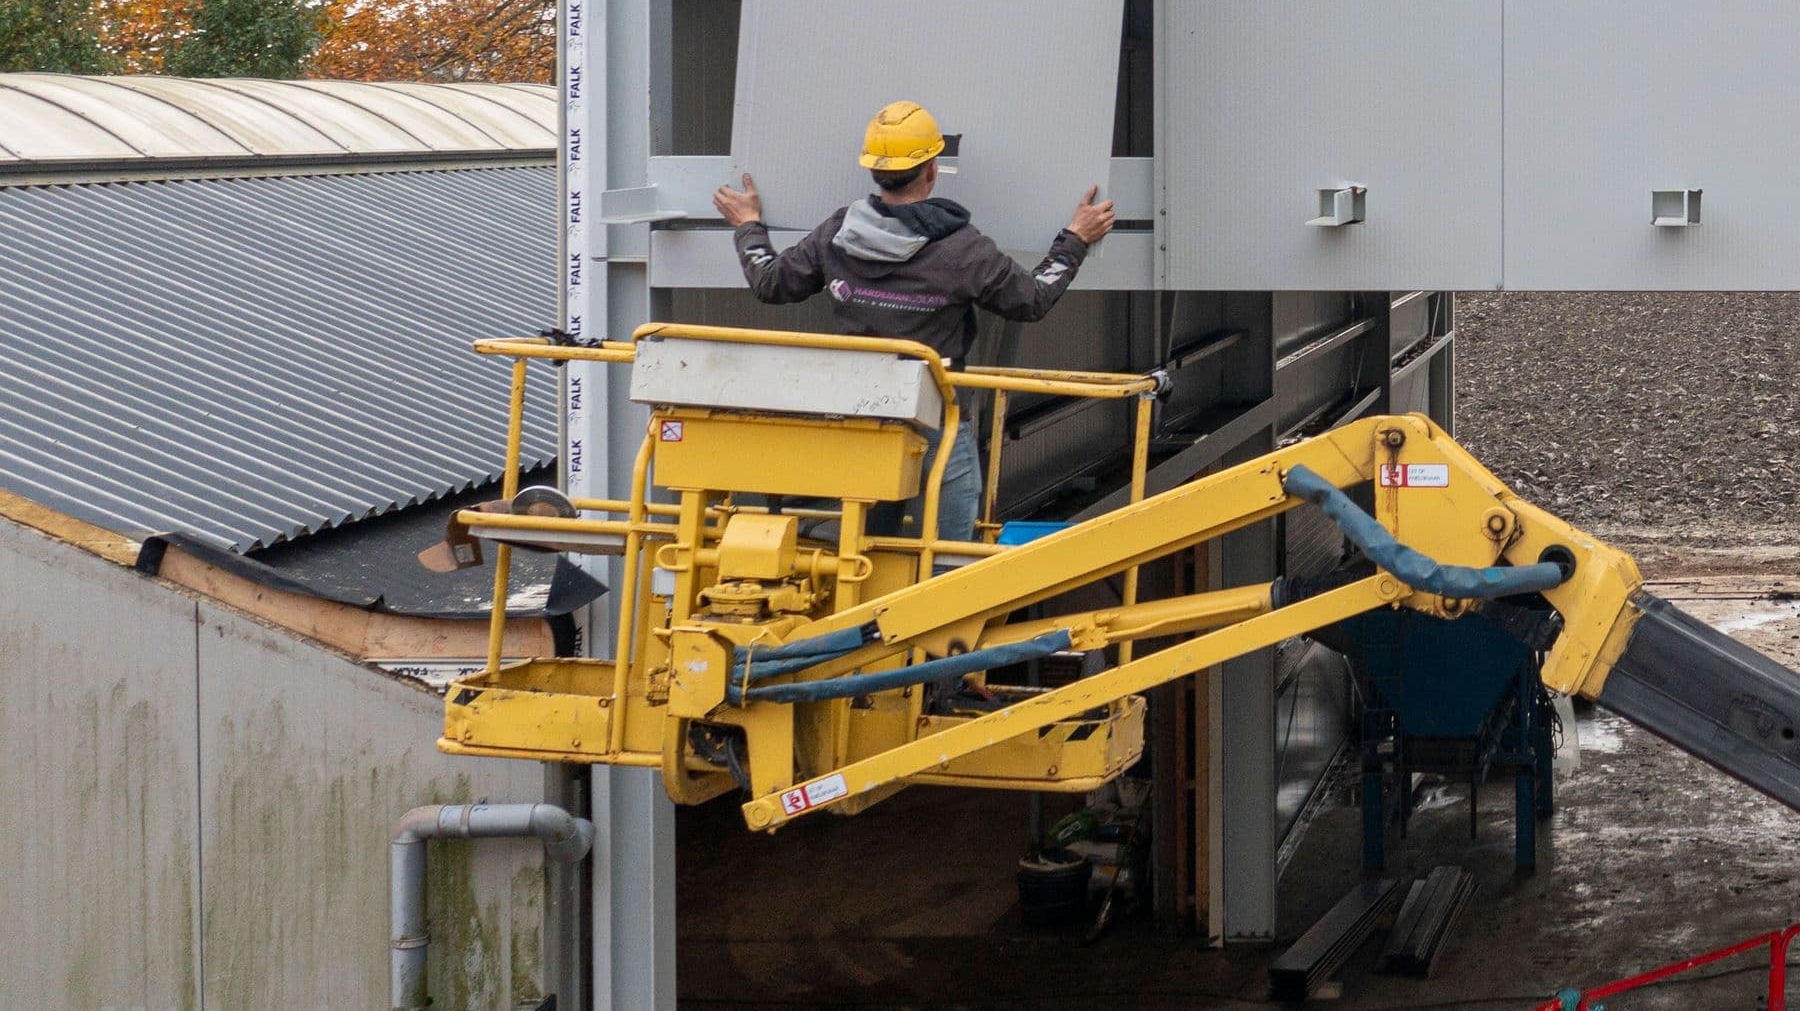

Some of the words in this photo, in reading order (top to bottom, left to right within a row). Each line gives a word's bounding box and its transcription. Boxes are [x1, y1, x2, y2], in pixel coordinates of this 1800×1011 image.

[570, 4, 581, 36] FALK
[570, 66, 581, 98] FALK
[570, 128, 581, 160] FALK
[570, 191, 581, 223] FALK
[570, 253, 581, 285] FALK
[570, 316, 582, 338] ALK
[571, 378, 582, 410] FALK
[571, 440, 582, 472] FALK
